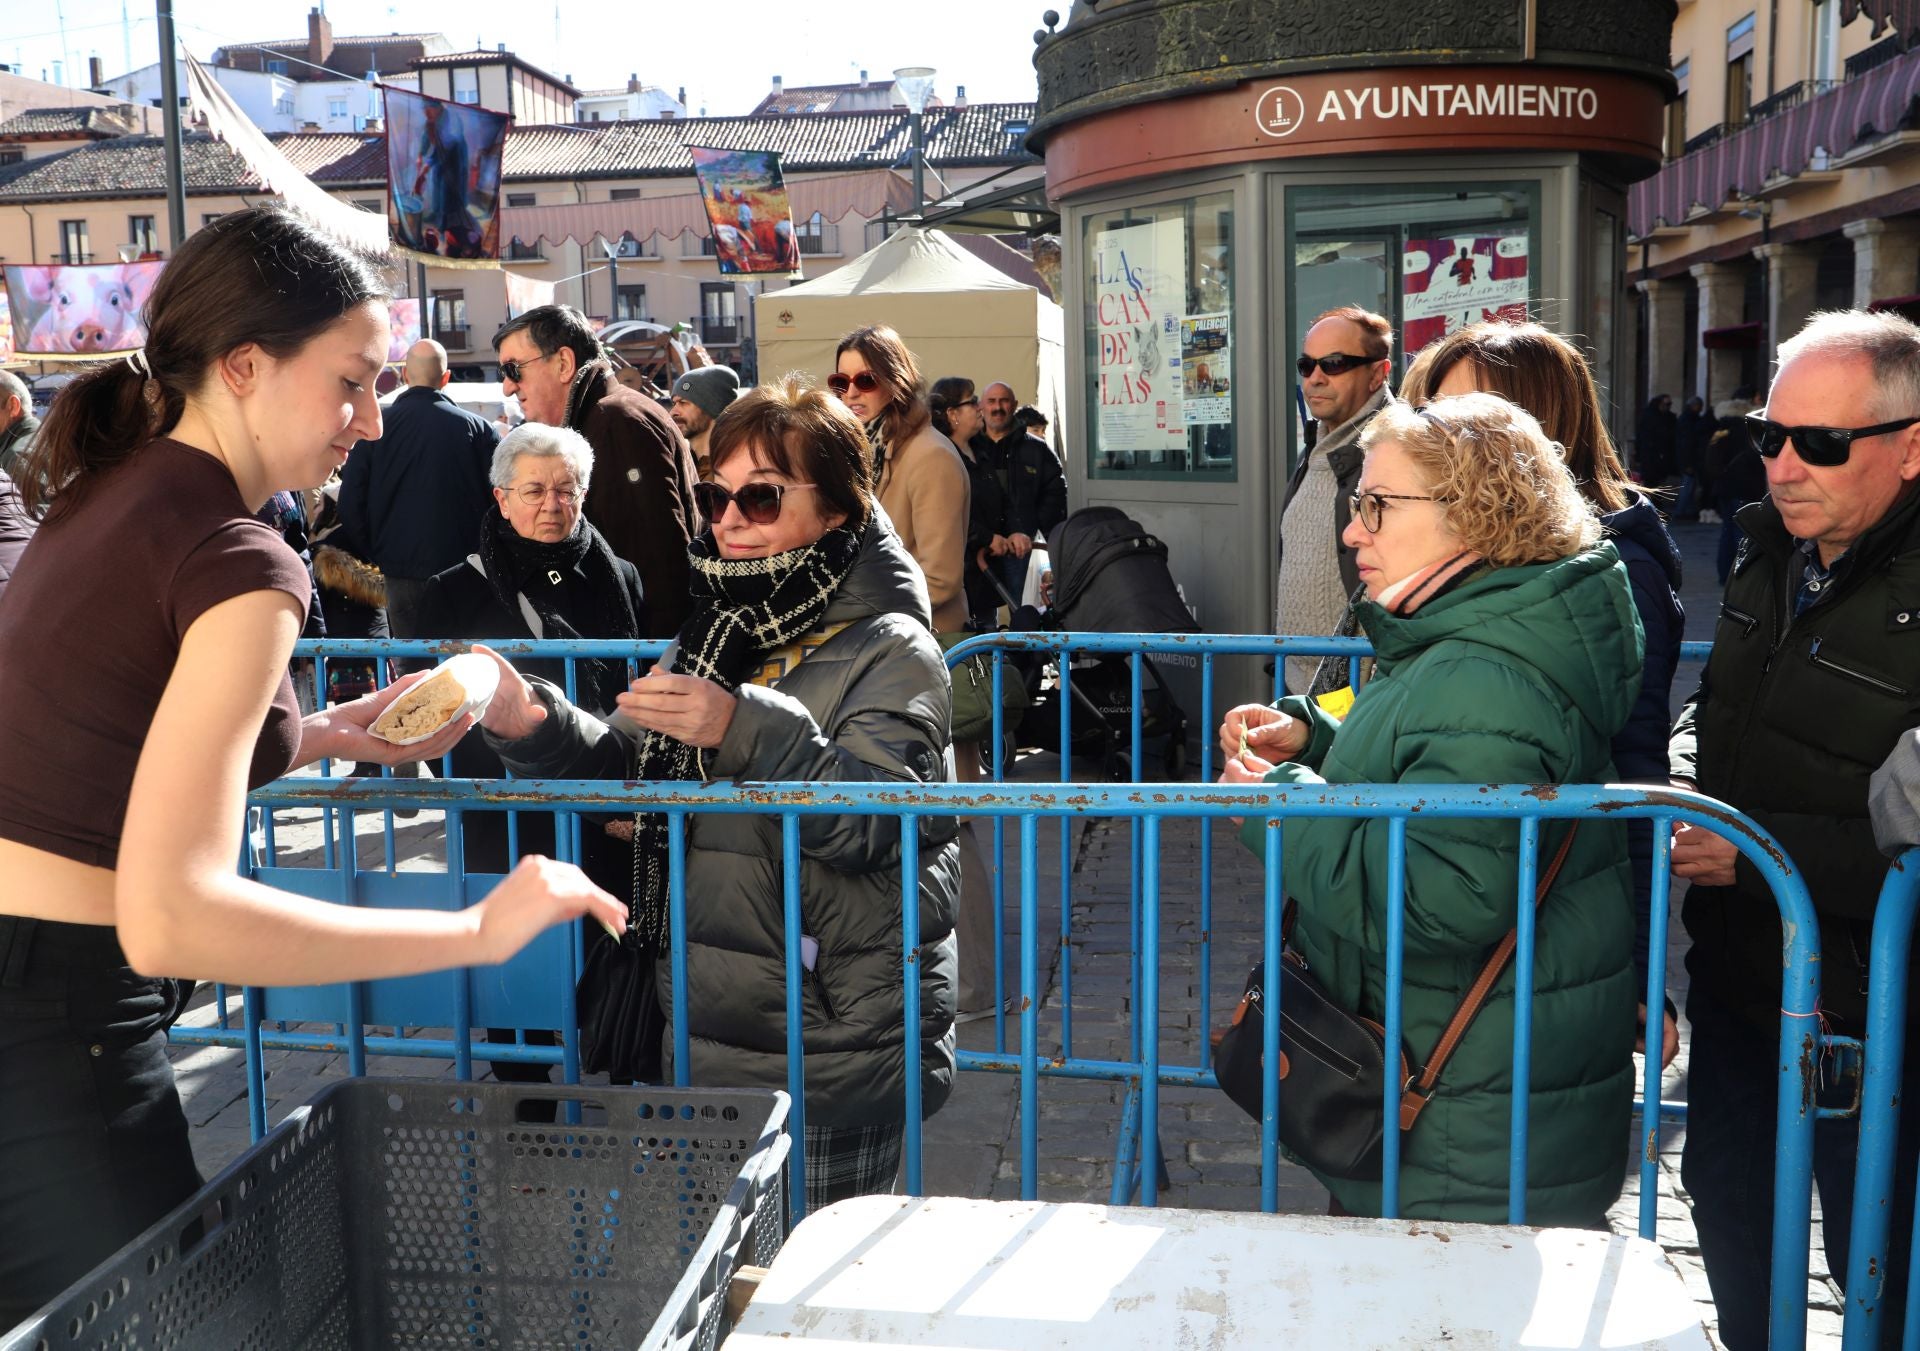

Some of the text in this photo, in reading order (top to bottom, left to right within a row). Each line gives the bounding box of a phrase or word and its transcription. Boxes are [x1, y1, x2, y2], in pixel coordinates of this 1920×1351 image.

[1317, 84, 1598, 122] AYUNTAMIENTO
[1099, 288, 1151, 326] CAN
[1195, 316, 1228, 331] PALENCIA
[1100, 331, 1133, 367] DE
[1101, 368, 1151, 406] LAS
